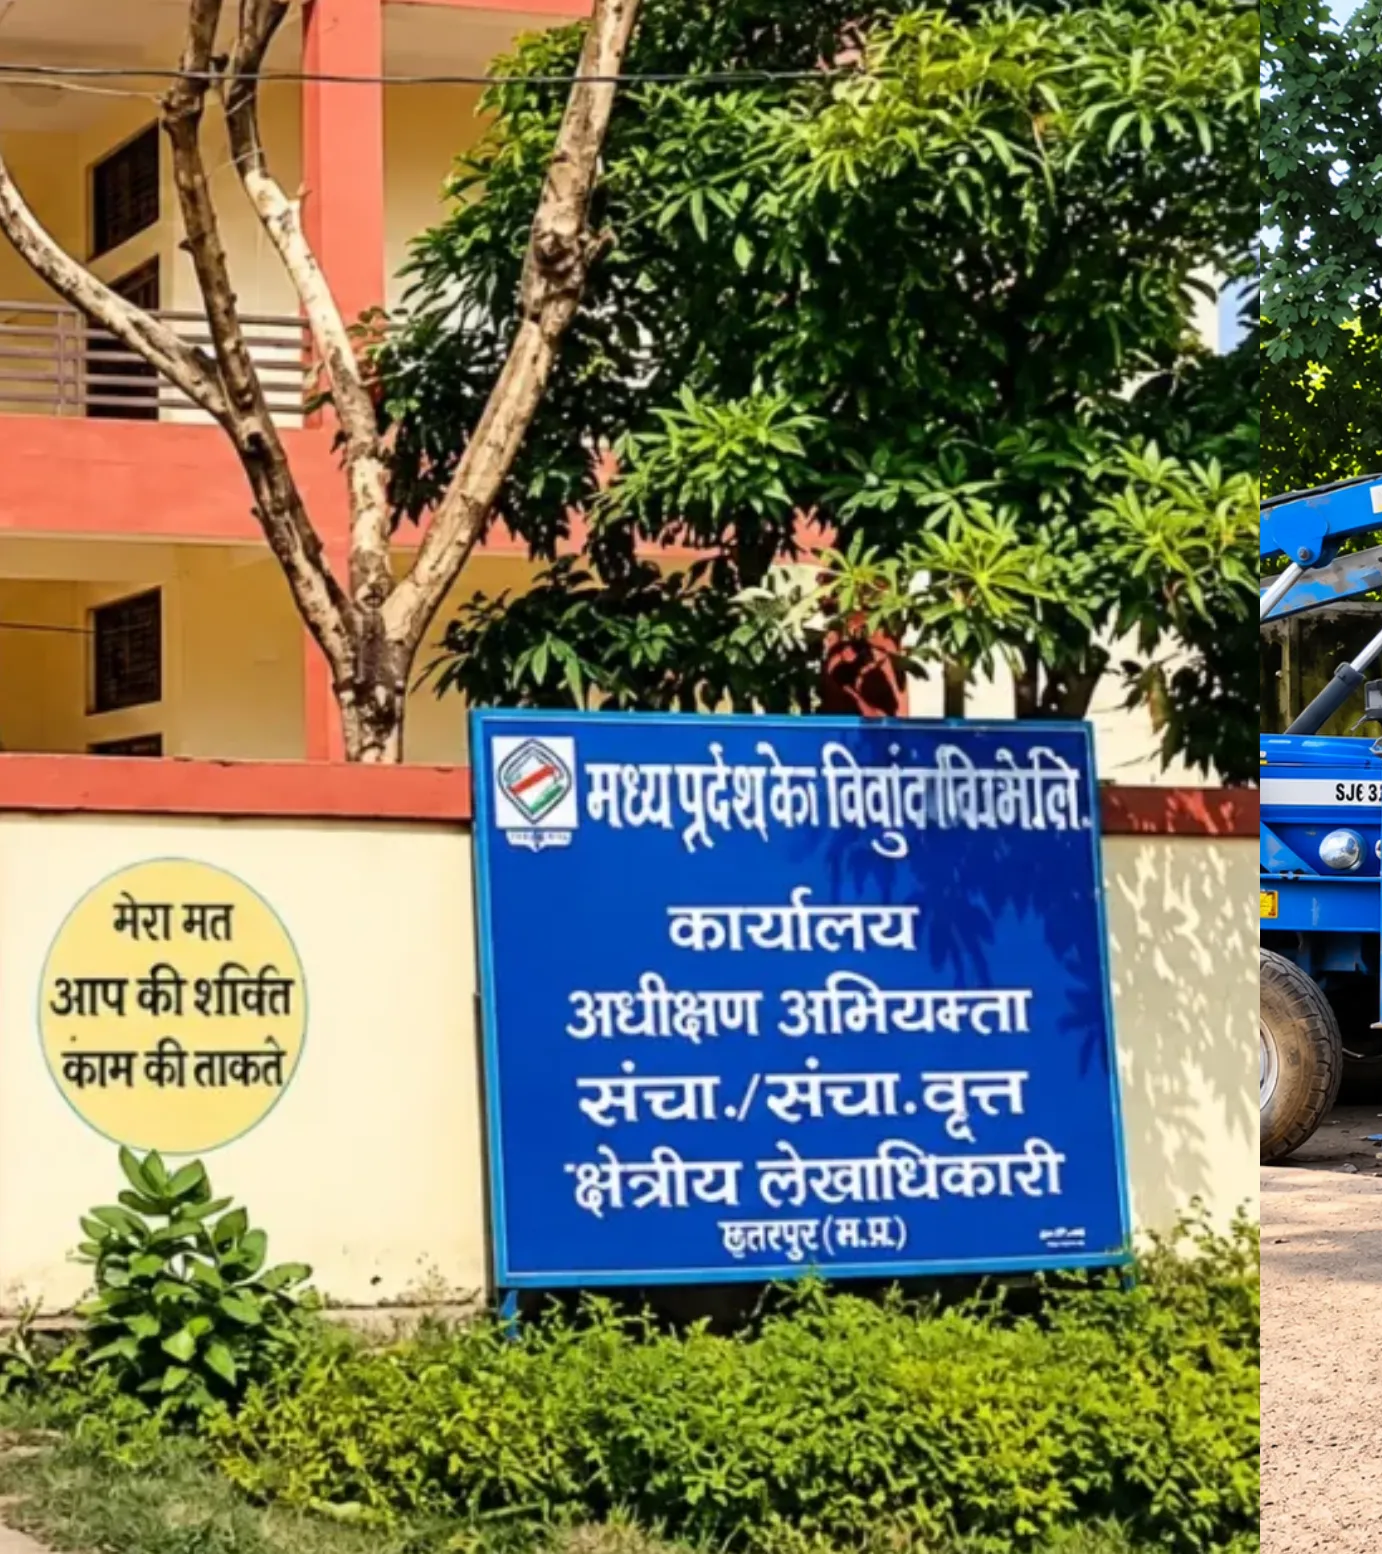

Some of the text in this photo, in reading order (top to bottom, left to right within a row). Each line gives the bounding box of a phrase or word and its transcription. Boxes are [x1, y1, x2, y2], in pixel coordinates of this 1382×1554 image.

[114, 892, 233, 940] मेरा मत
[668, 887, 919, 951] कार्यालय
[51, 979, 128, 1016] आप
[137, 963, 187, 1015] की
[567, 973, 762, 1043] अधीक्षण
[145, 1038, 188, 1087] की
[565, 1139, 1064, 1217] क्षेत्रीय लेखाधिकारी
